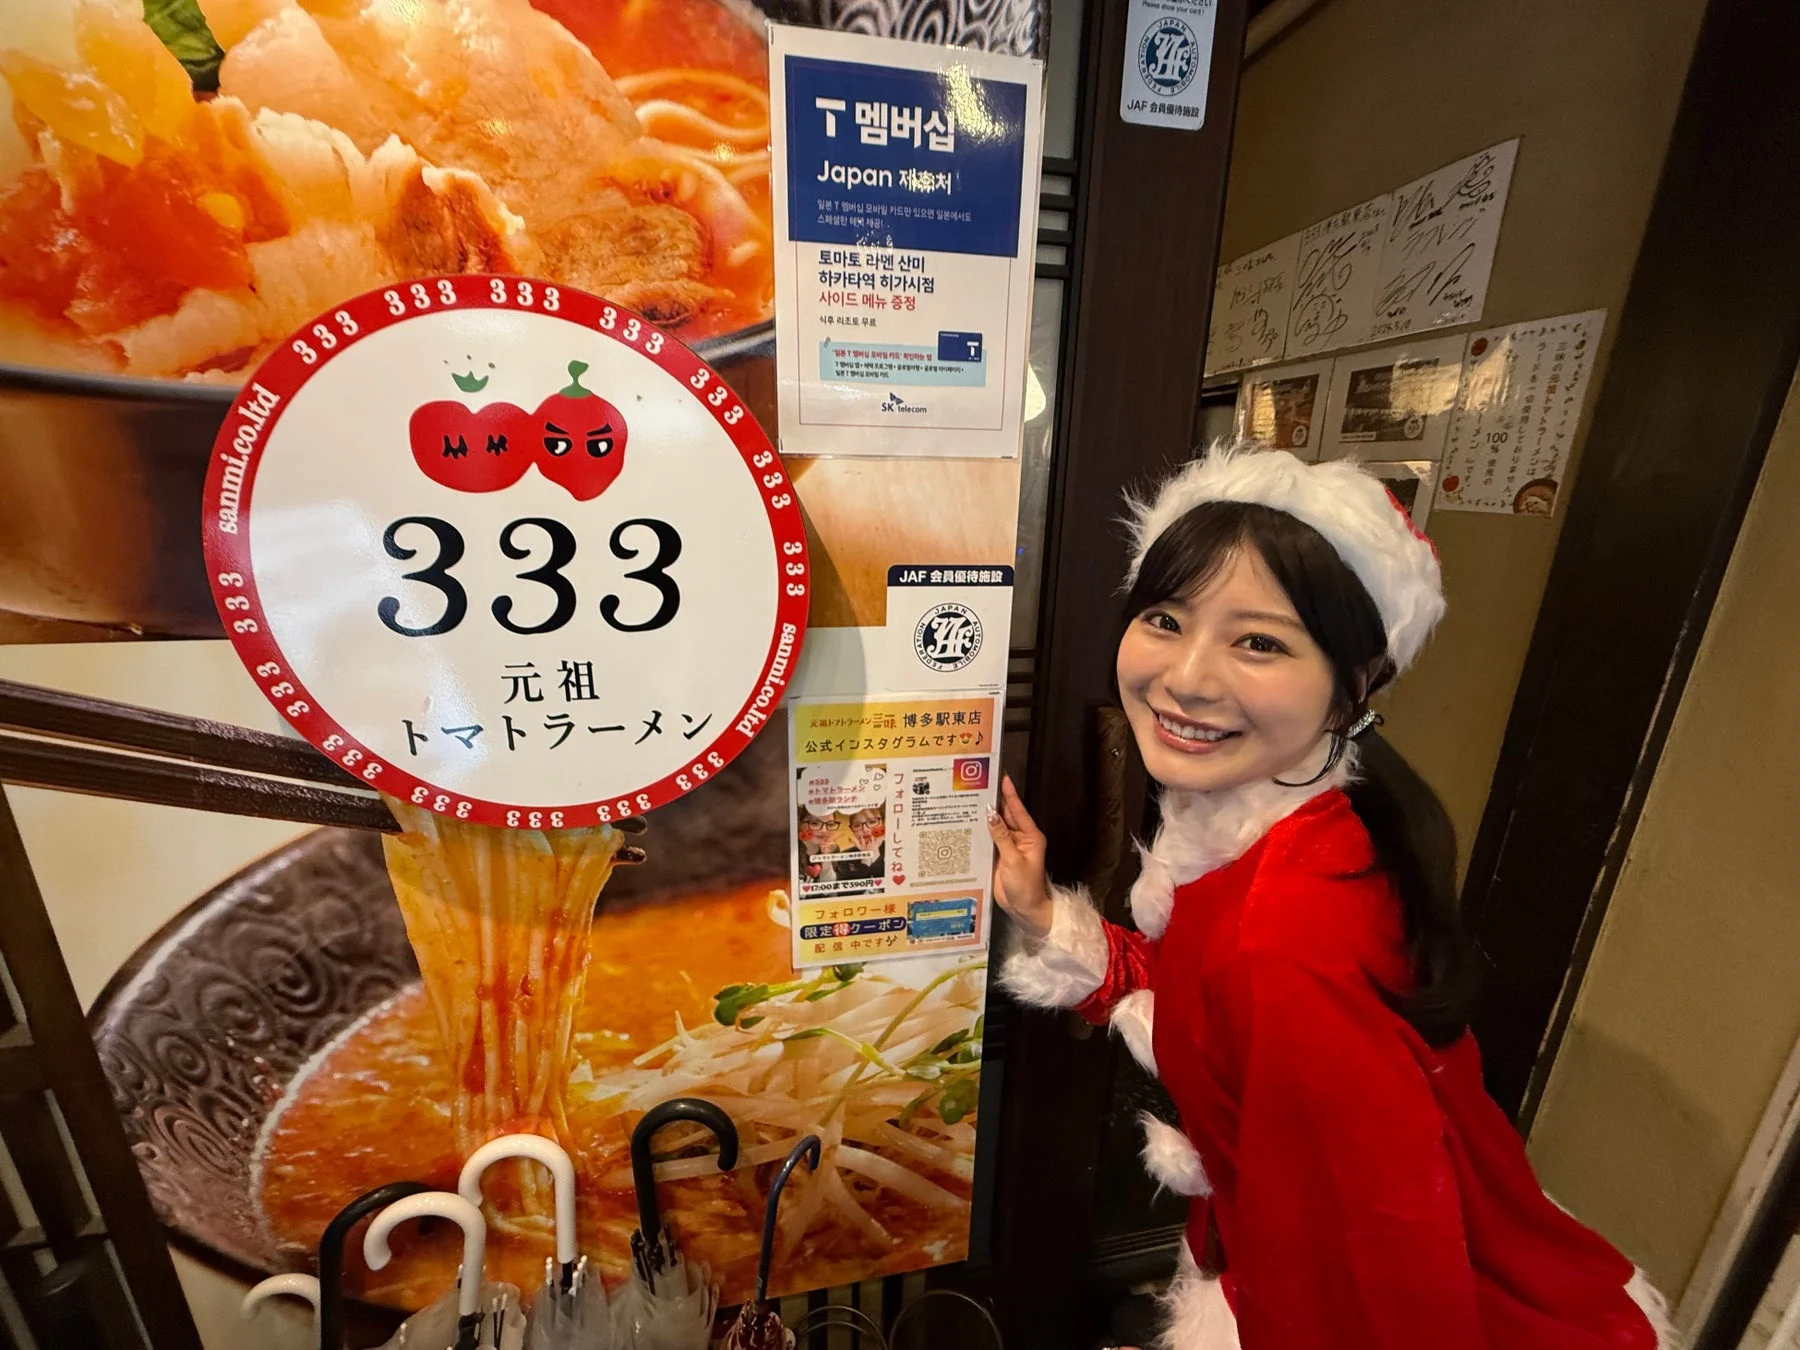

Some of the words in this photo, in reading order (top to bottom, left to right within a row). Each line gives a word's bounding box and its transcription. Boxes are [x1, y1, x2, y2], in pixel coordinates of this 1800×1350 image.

[1159, 20, 1187, 32] JAPAN
[1127, 99, 1148, 111] JAF
[1150, 101, 1200, 118] 会員優待施設
[815, 97, 847, 138] T
[855, 101, 956, 153] 멤버십
[816, 160, 893, 190] Japan
[817, 199, 833, 211] 일본
[841, 202, 864, 215] 멤버십
[865, 203, 888, 216] 모바일
[818, 250, 862, 268] 토마토
[865, 252, 894, 271] 라멘
[897, 255, 925, 273] 산미
[818, 270, 876, 290] 하카타역
[879, 273, 935, 294] 히가시점
[819, 290, 859, 307] 사이드
[861, 293, 888, 310] 메뉴
[890, 294, 916, 311] 증정
[881, 402, 894, 412] SK
[897, 404, 927, 414] telecom
[292, 310, 359, 365] 333
[383, 279, 457, 316] 333
[489, 278, 560, 312] 333
[599, 306, 664, 355] 333
[689, 367, 744, 425] 333
[752, 450, 791, 510] 333
[783, 541, 805, 597] 333
[377, 516, 682, 637] 333
[899, 570, 927, 583] JAF
[930, 569, 1003, 583] 会員優待施設
[934, 604, 968, 615] JAPAN
[916, 621, 943, 670] FEDERATION
[952, 620, 981, 669] AUTOMOBILE
[500, 660, 600, 705] 元祖
[903, 710, 982, 729] 博多駅東店
[402, 709, 713, 756] トマトラーメン
[805, 733, 958, 753] 公式インスタグラムです
[890, 773, 905, 872] フォローしてね
[815, 904, 896, 920] フォロワー様
[814, 936, 884, 954] 配信中です
